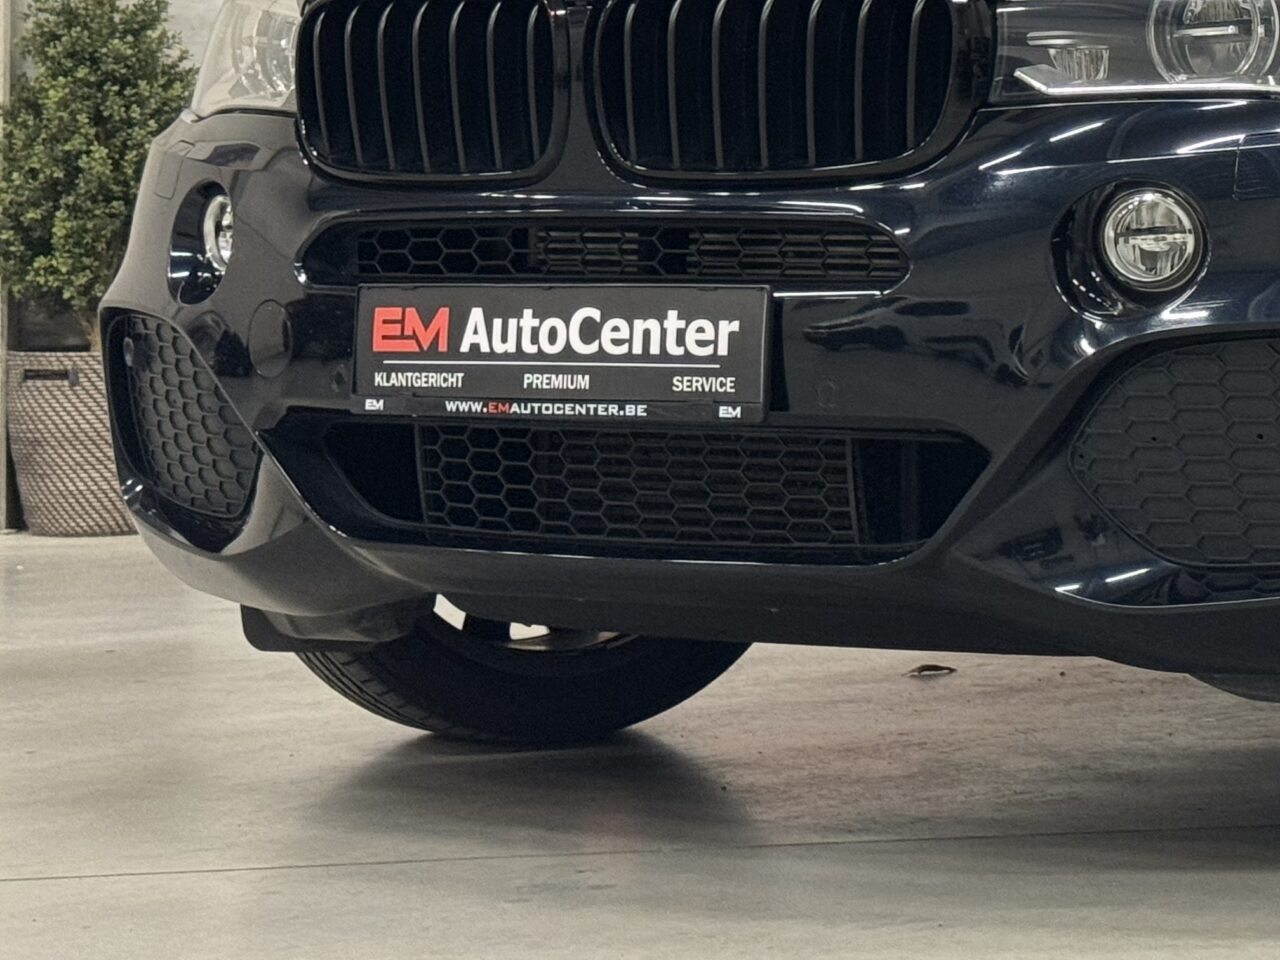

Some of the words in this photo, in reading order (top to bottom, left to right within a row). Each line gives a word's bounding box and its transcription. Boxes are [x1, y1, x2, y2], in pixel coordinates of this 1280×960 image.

[372, 306, 449, 353] EM
[459, 306, 740, 357] AutoCenter
[374, 372, 464, 388] KLANTGERICHT
[523, 373, 590, 390] PREMIUM
[672, 376, 736, 392] SERVICE
[364, 398, 384, 411] EM
[445, 400, 647, 417] WWW.EMAUTOCENTER.BE
[718, 405, 742, 419] EM
